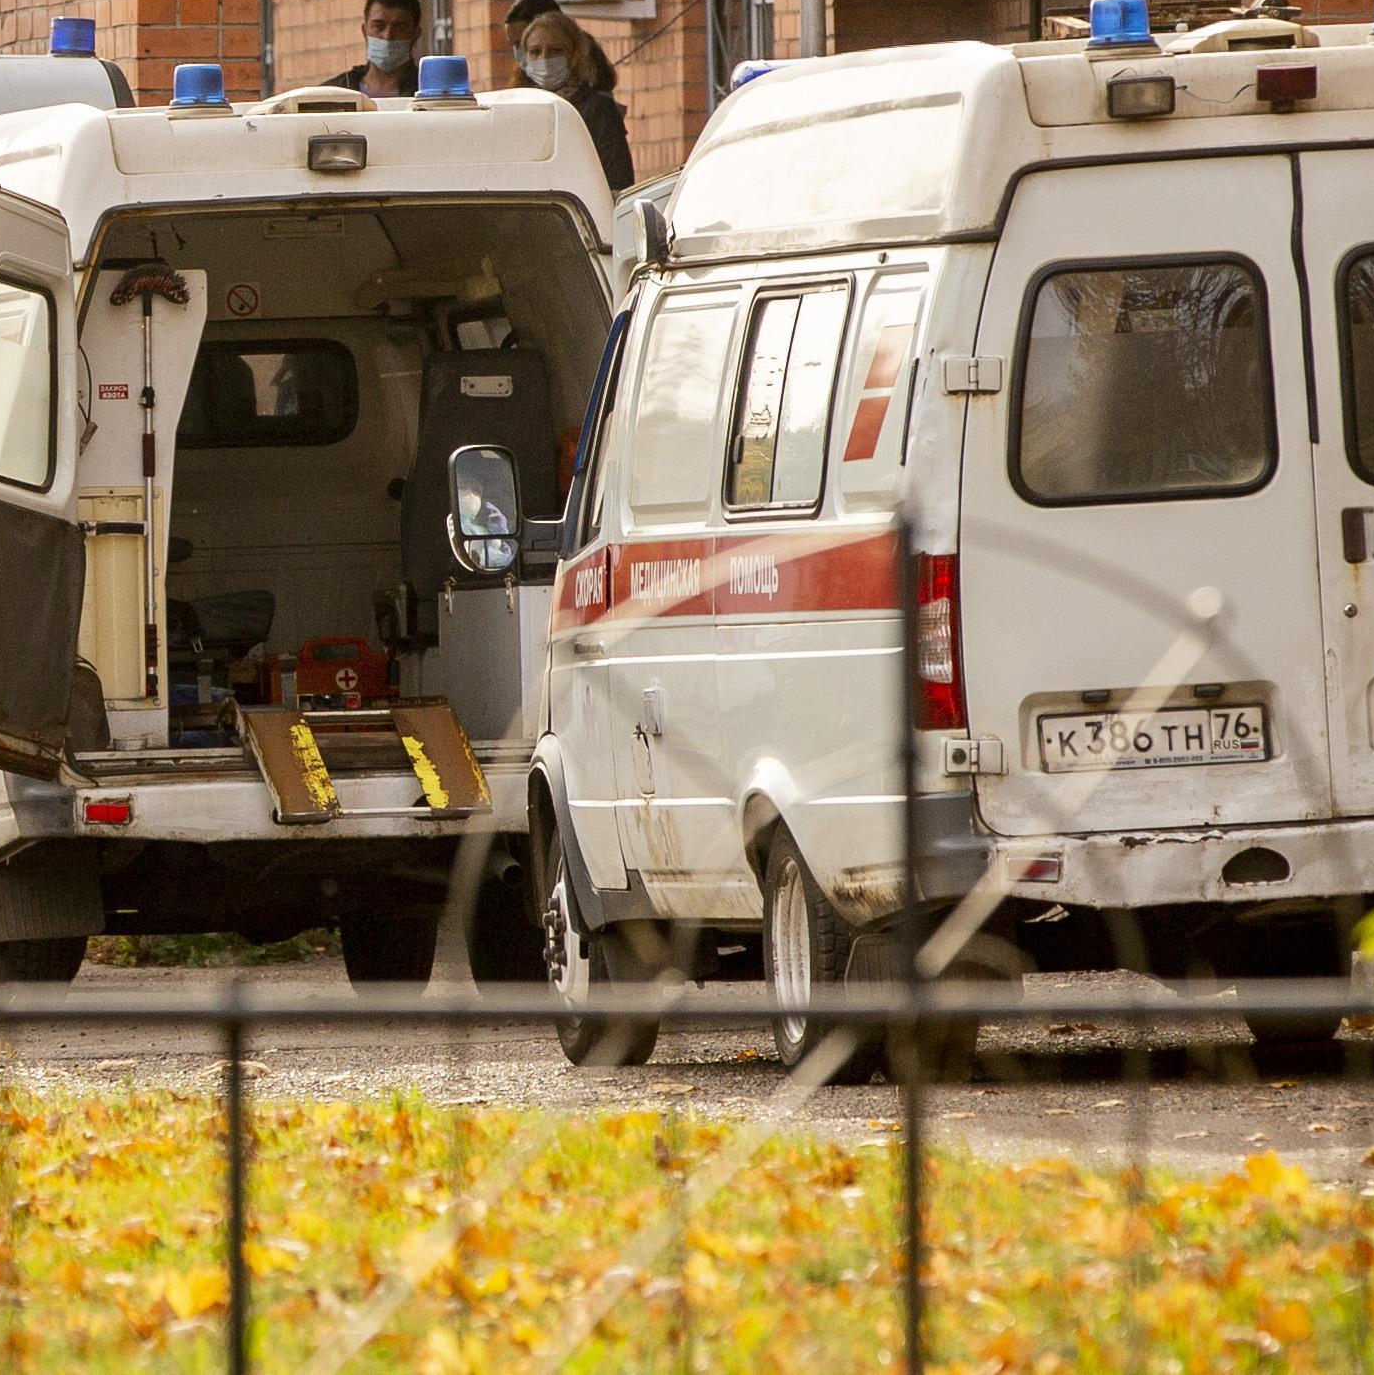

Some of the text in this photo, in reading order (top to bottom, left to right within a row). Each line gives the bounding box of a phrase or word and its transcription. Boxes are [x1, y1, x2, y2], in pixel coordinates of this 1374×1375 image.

[575, 554, 779, 609] СКОРАЯ МЕДИЦИНСКАЯ ПОМОЩЬ
[1214, 712, 1251, 739] 76
[1213, 739, 1240, 750] RUS
